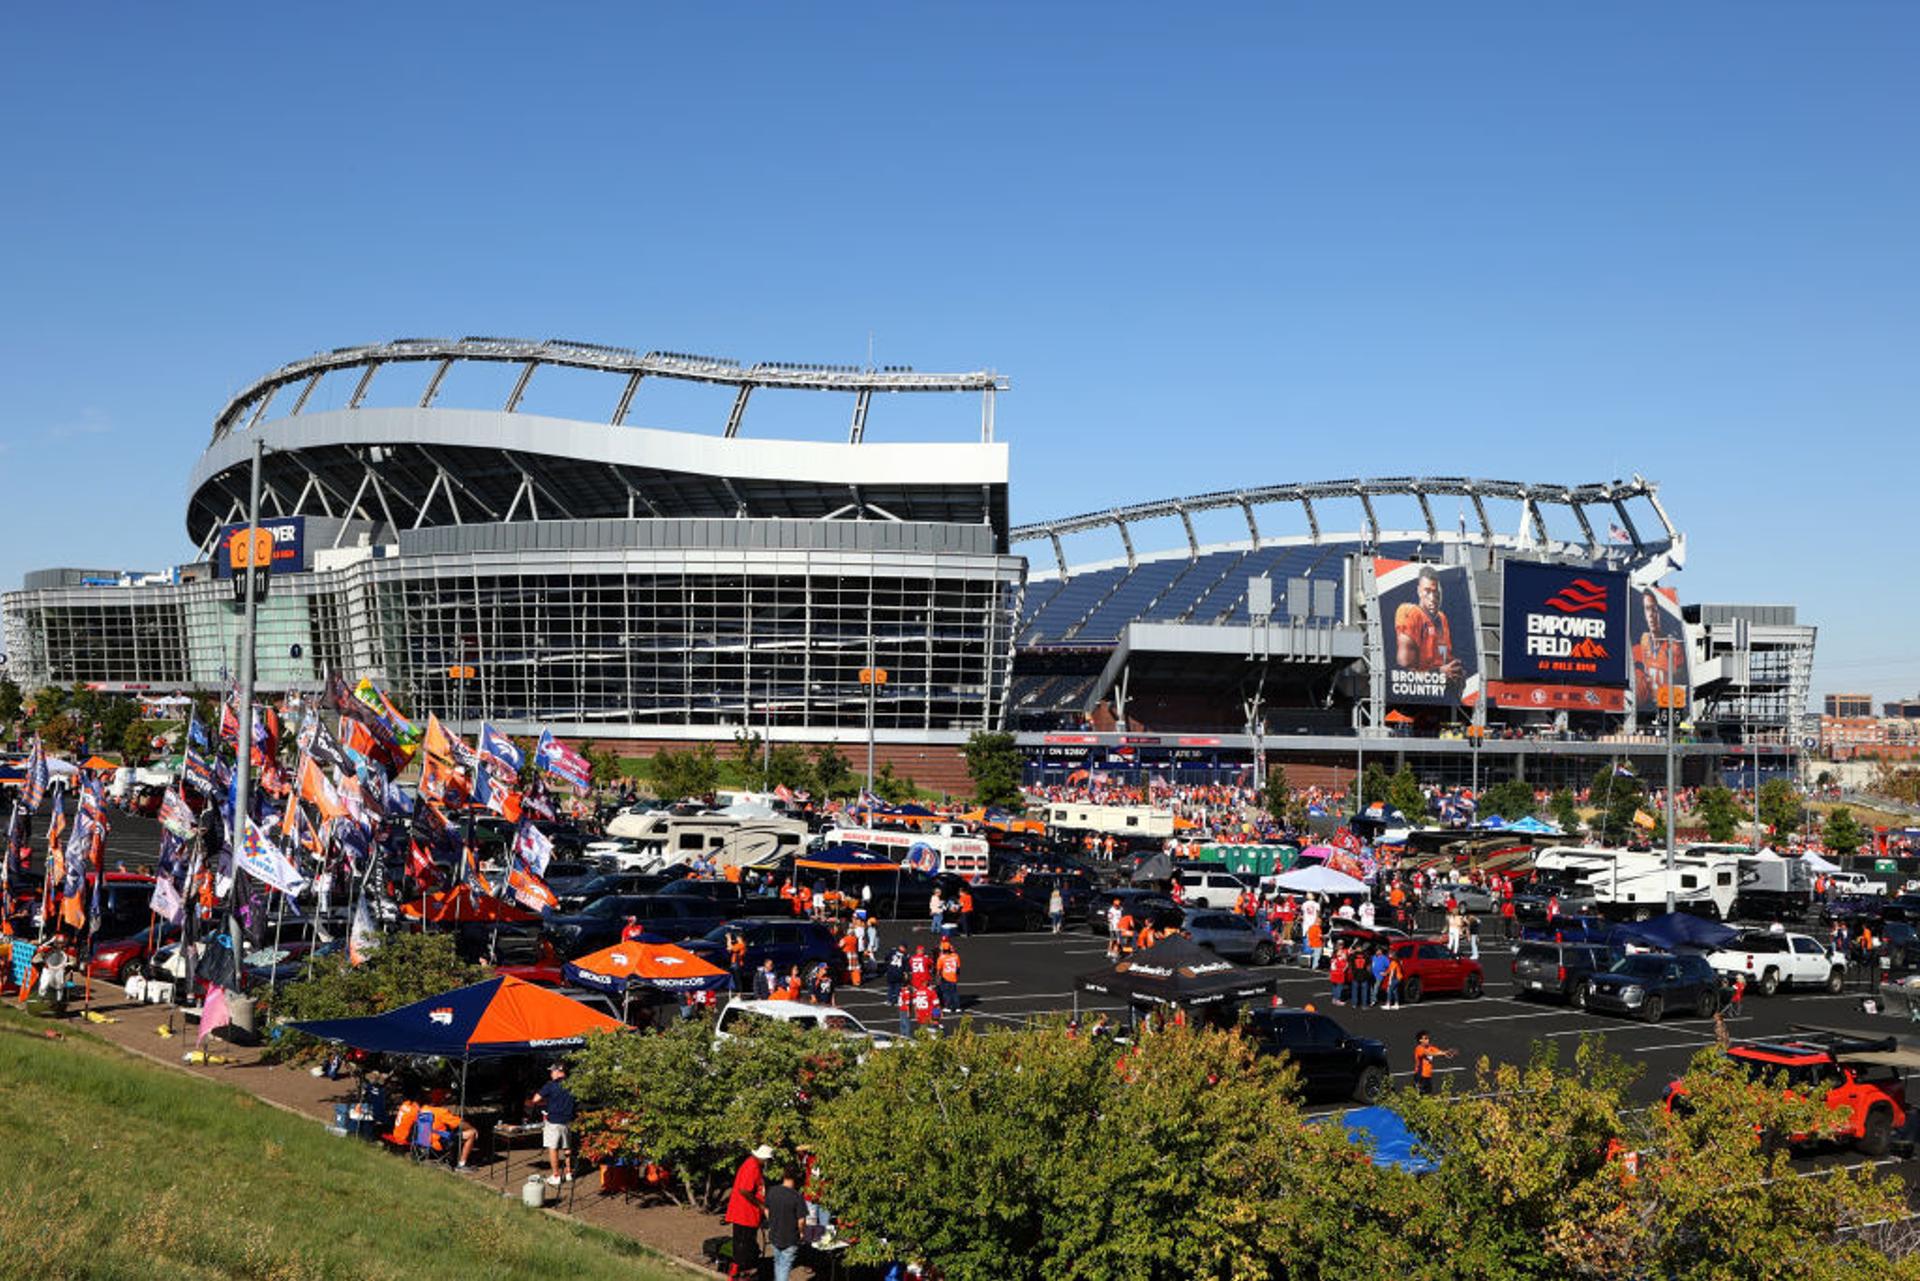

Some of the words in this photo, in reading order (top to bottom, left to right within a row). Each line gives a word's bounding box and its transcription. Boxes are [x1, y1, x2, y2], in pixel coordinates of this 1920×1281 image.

[237, 542, 246, 562] C
[258, 540, 265, 560] C
[1527, 613, 1606, 639] EMPOWER
[1527, 635, 1572, 657] FIELD
[1391, 669, 1447, 684] BRONCOS
[1392, 682, 1447, 697] COUNTRY
[578, 970, 612, 984] BRONCOS
